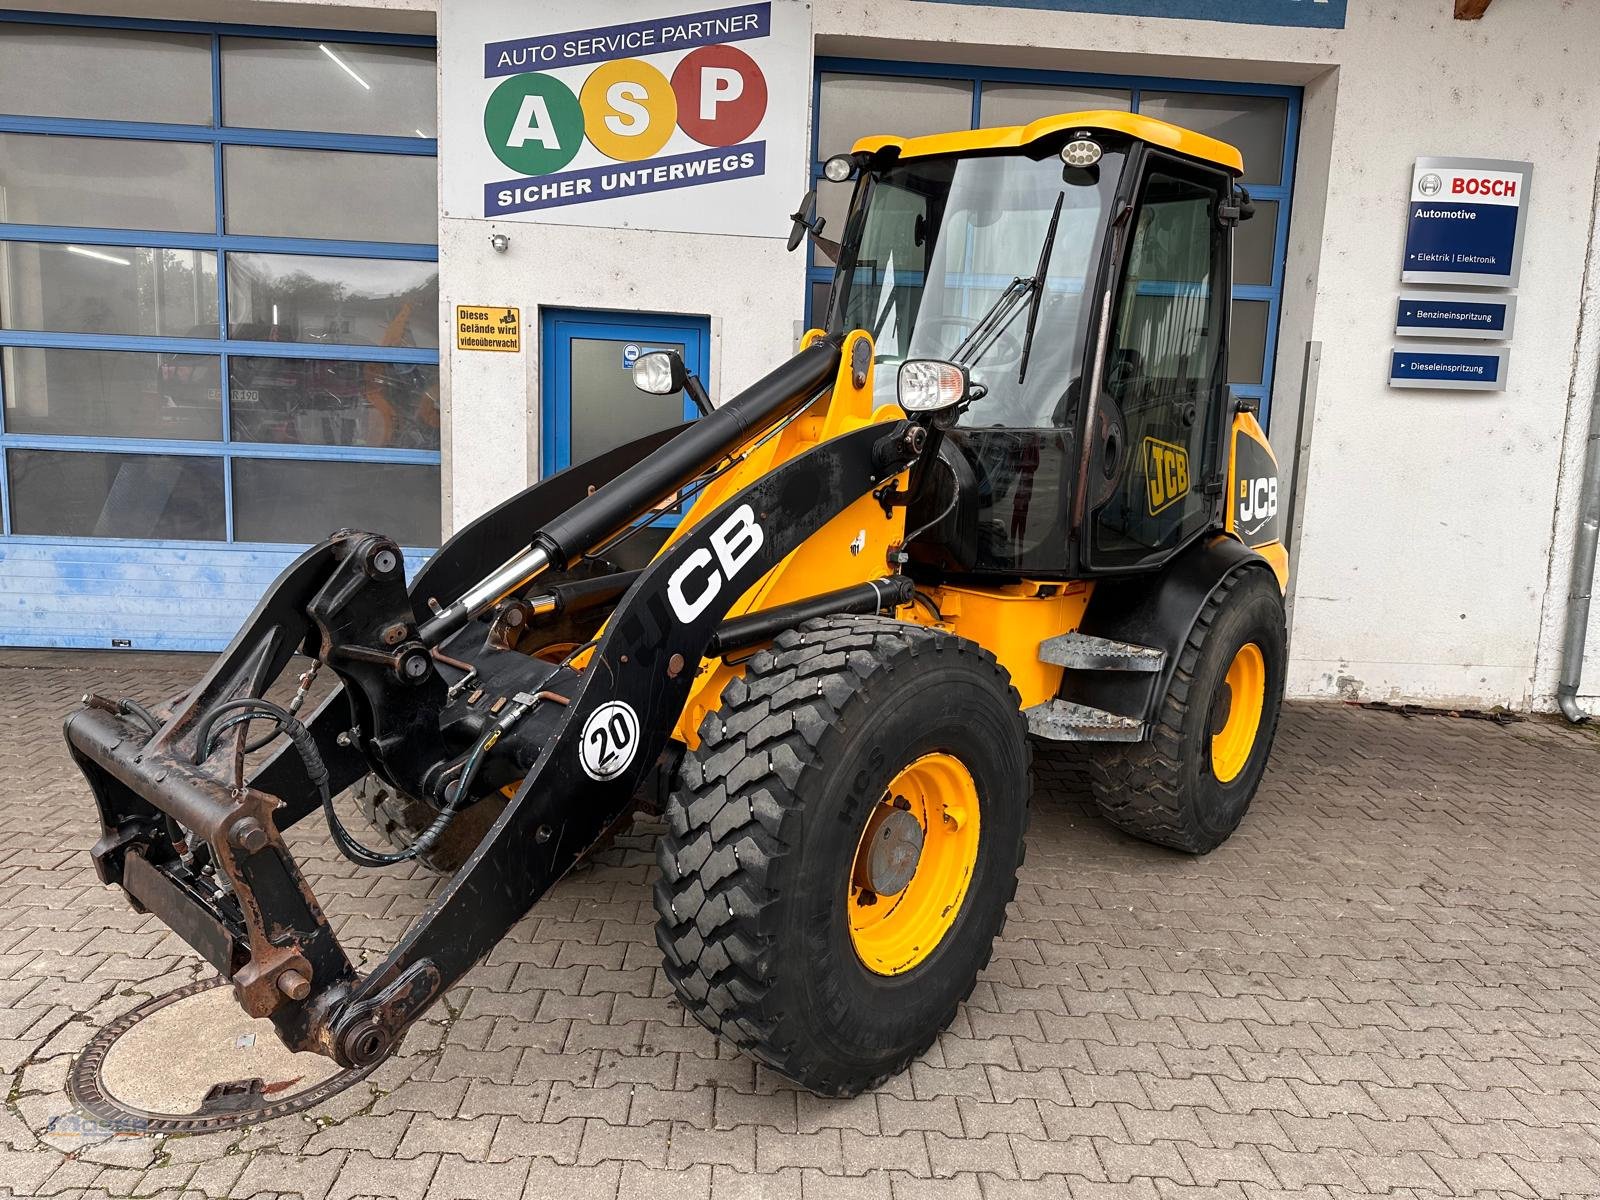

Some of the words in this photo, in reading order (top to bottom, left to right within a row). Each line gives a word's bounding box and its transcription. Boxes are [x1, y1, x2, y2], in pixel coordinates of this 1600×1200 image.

[497, 45, 557, 68] AUTO
[563, 29, 655, 58] SERVICE
[662, 13, 759, 43] PARTNER
[497, 178, 592, 207] SICHER
[601, 152, 755, 191] UNTERWEGS
[1451, 177, 1517, 197] BOSCH
[1414, 208, 1477, 220] Automotive
[1417, 252, 1450, 262] Elektrik
[1456, 254, 1496, 264] Elektronik
[460, 310, 489, 320] Dieses
[1416, 310, 1492, 323] Benzineinspritzung
[460, 323, 495, 334] Gelände
[497, 325, 517, 335] wird
[460, 336, 518, 349] videoüberwacht
[1410, 362, 1484, 375] Dieseleinspritzung
[1150, 445, 1188, 507] JCB
[1239, 476, 1278, 522] JCB
[590, 712, 631, 767] 20
